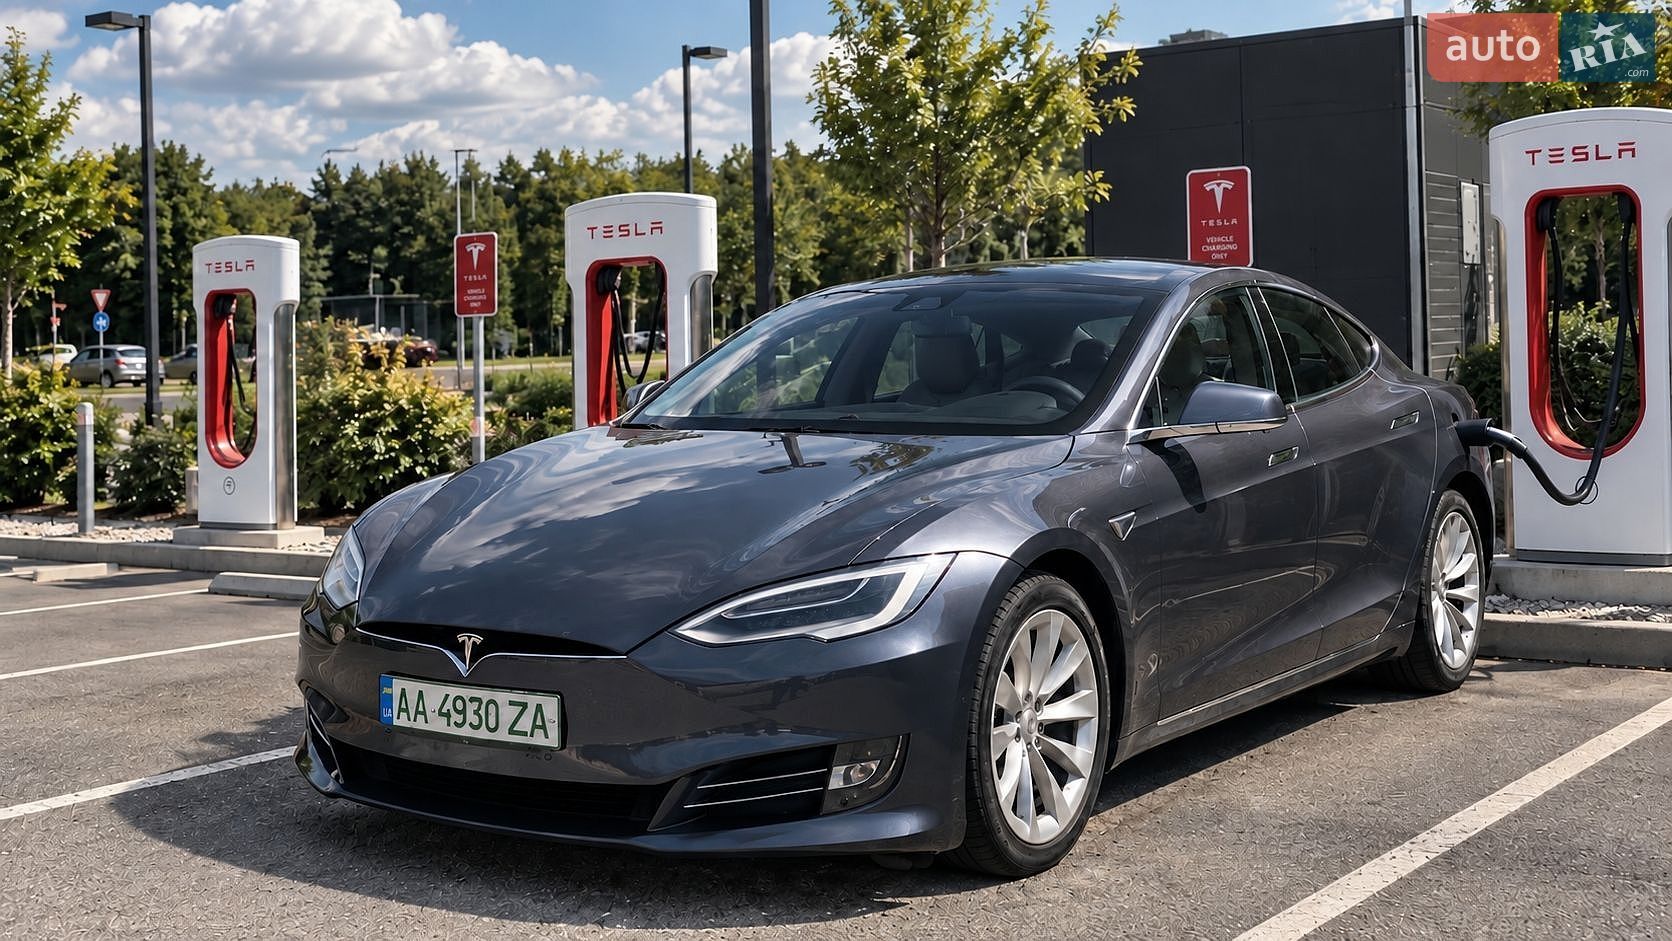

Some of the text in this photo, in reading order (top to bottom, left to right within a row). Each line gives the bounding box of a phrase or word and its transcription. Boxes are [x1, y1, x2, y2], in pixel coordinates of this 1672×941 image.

[1525, 141, 1637, 166] TESLA
[587, 221, 663, 240] TESLA
[1201, 218, 1238, 227] TESLA
[205, 259, 255, 274] TESLA
[382, 707, 392, 718] UA
[396, 687, 549, 739] AA 4930 ZA
